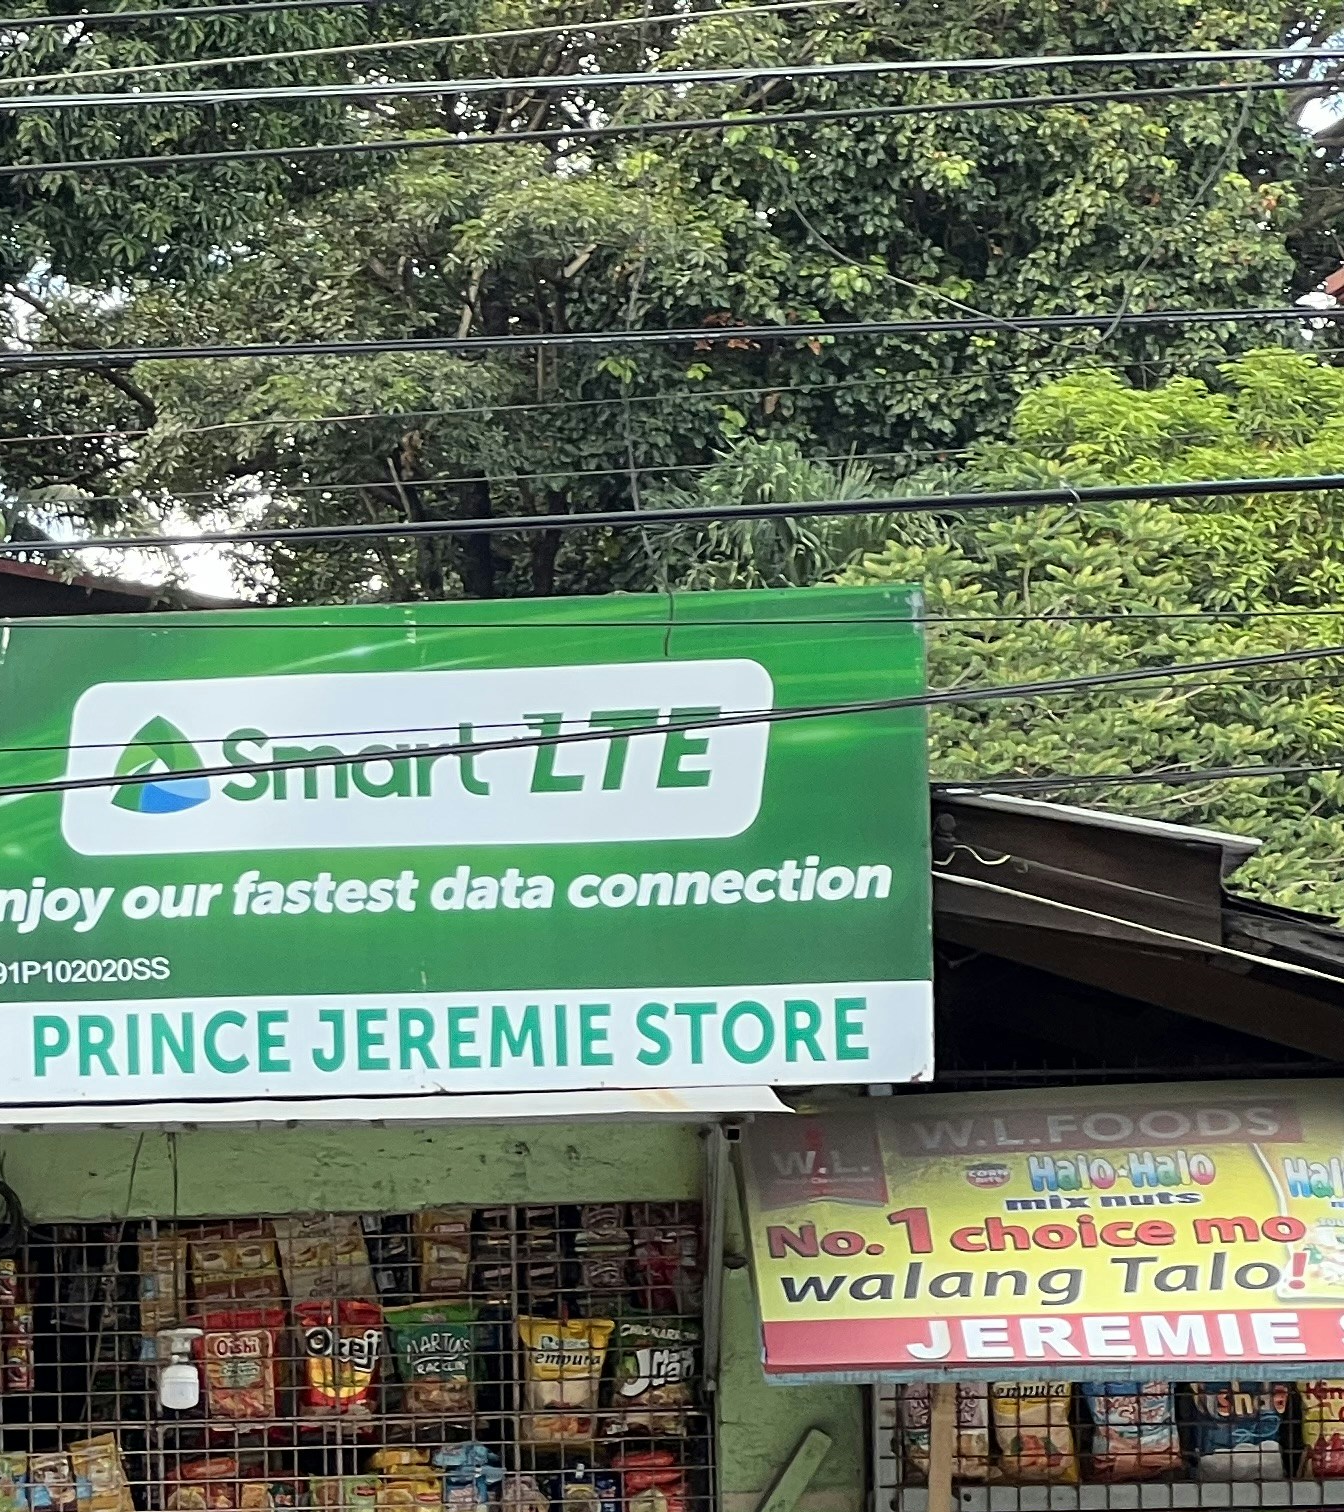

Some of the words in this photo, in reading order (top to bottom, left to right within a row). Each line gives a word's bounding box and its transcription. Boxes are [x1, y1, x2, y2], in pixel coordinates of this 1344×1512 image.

[221, 720, 492, 802] Smart
[523, 704, 723, 794] LTE
[122, 880, 223, 920] our
[231, 864, 424, 916] fastest
[431, 864, 555, 913] data
[566, 856, 894, 908] connection
[31, 1009, 293, 1077] PRINCE
[312, 1002, 614, 1073] JEREMIE
[634, 998, 870, 1067] STORE
[771, 1150, 872, 1177] W.L.
[1006, 1195, 1090, 1212] mix
[1100, 1192, 1202, 1208] nuts
[949, 1214, 1176, 1254] choice
[1193, 1215, 1307, 1244] mo
[782, 1261, 1083, 1306] walang
[1110, 1252, 1308, 1294] Talo!
[215, 1338, 259, 1358] Oishi
[905, 1312, 1307, 1361] JEREMIE
